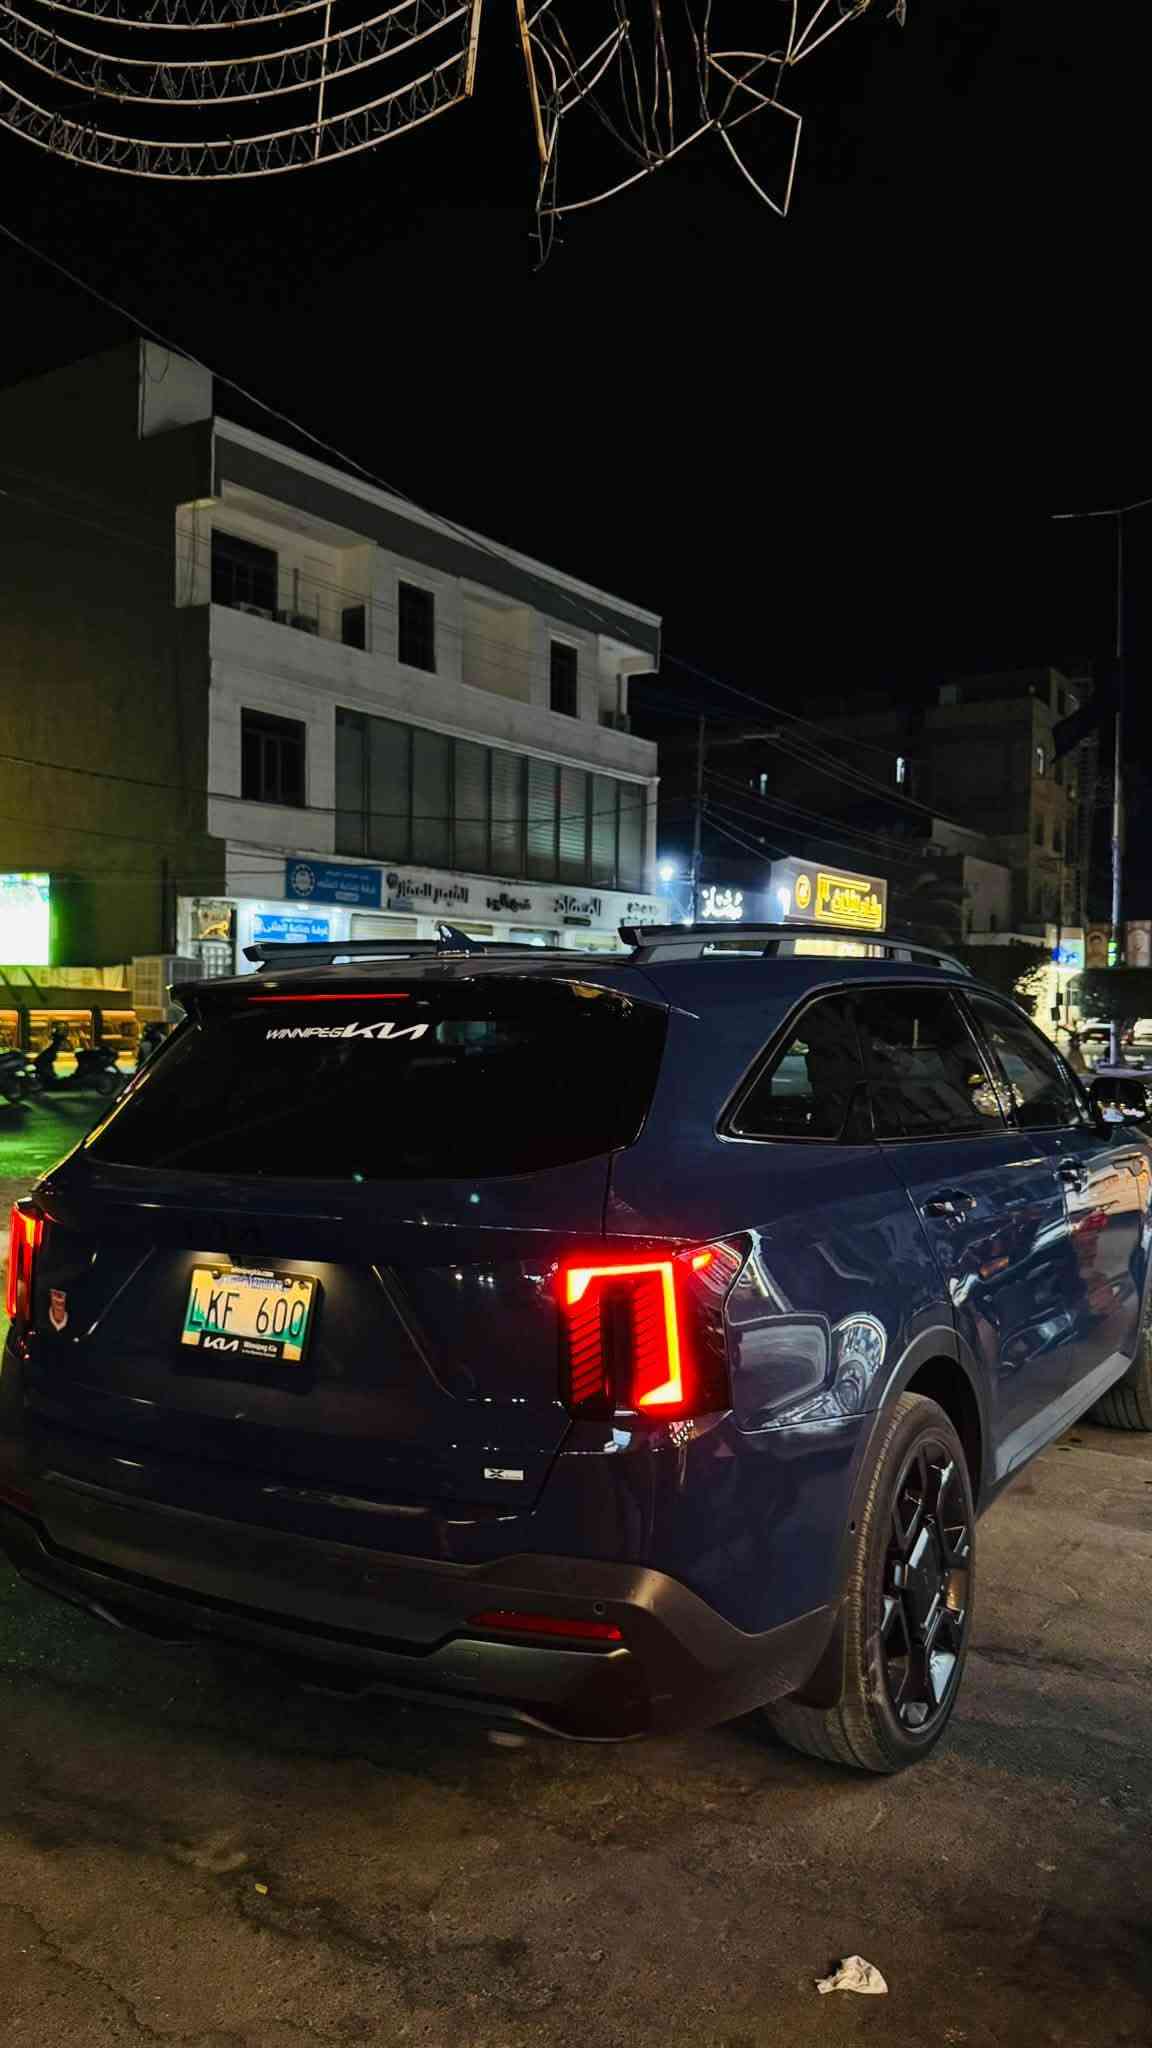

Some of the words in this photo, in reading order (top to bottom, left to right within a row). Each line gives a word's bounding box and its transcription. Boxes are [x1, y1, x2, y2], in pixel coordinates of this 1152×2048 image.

[265, 1026, 345, 1040] WINNIPEG
[189, 1287, 240, 1331] LKF
[256, 1296, 306, 1338] 600
